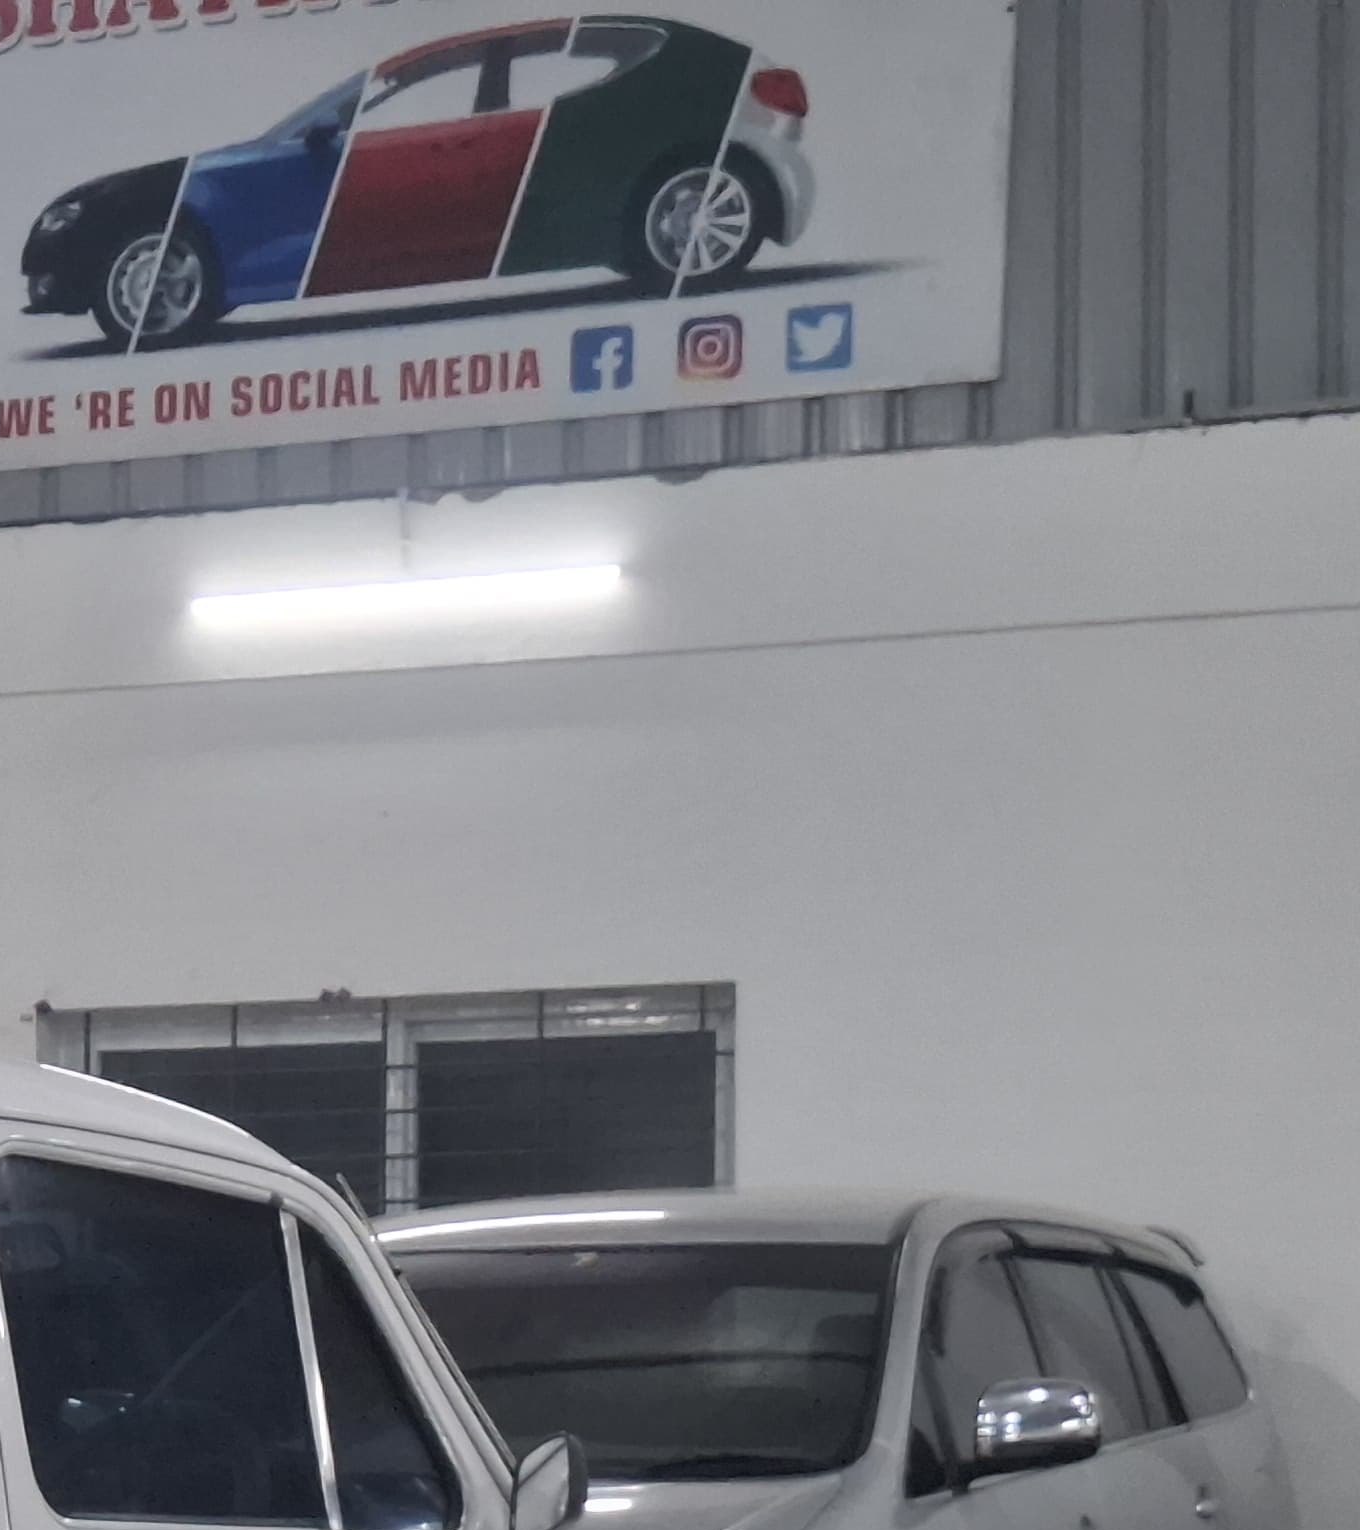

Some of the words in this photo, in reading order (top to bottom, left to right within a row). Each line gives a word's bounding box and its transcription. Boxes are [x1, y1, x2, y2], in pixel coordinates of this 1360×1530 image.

[153, 380, 212, 424] ON
[230, 364, 381, 418] SOCIAL
[399, 346, 541, 402] MEDIA
